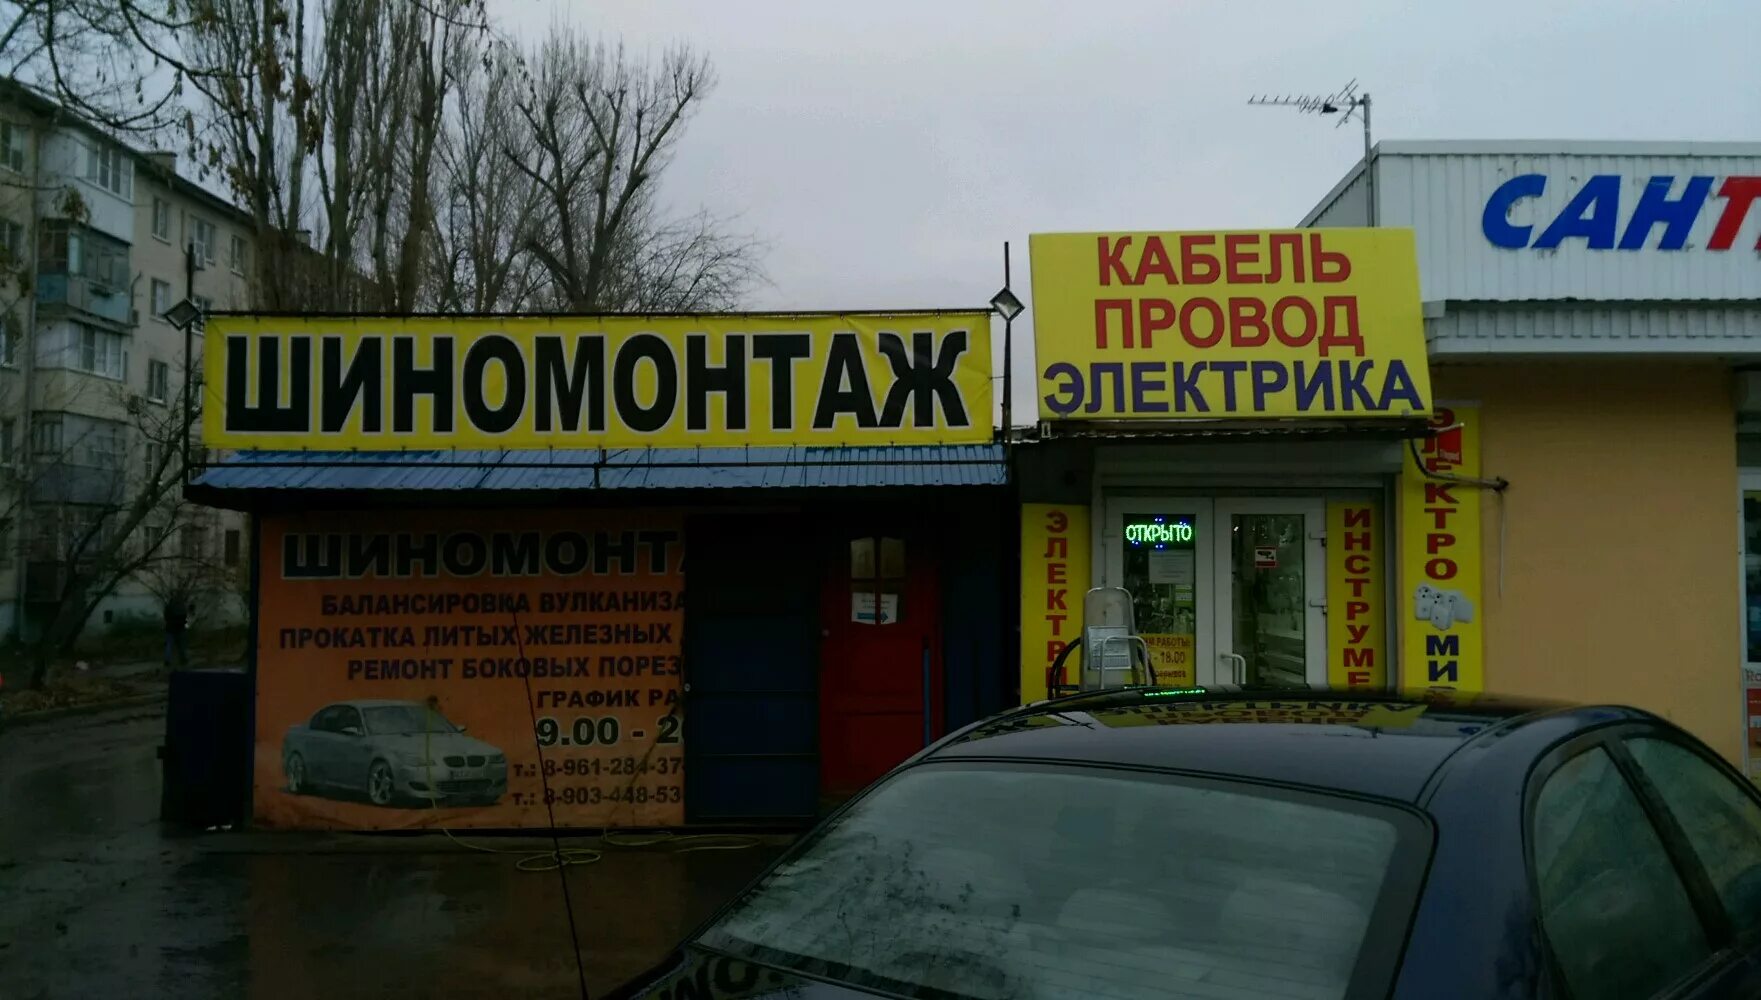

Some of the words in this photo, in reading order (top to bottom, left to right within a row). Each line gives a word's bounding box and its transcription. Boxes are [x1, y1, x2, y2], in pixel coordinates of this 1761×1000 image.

[1482, 174, 1761, 250] САНТ
[1097, 233, 1351, 286] КАБЕЛЬ
[1094, 295, 1365, 357] ПРОВОД
[225, 331, 969, 432] ШИНОМОНТАЖ
[1043, 359, 1424, 414] ЭЛЕКТРИКА
[283, 531, 686, 579] ШИНОМОНТ
[1125, 524, 1192, 542] ОТКРЫТО
[322, 592, 529, 616] БАЛАНСИРОВКА
[280, 625, 417, 649] ПРОКАТКА
[422, 624, 517, 648] ЛИТЫХ
[524, 622, 673, 645] ЖЕЛЕЗНЫХ
[348, 658, 453, 681] РЕМОНТ
[462, 656, 589, 680] БОКОВЫХ
[598, 654, 686, 678] ПОРЕЗ
[1425, 634, 1460, 692] МИ
[536, 689, 639, 708] ГРАФИК
[536, 716, 620, 747] 9.00
[655, 715, 686, 746] 2
